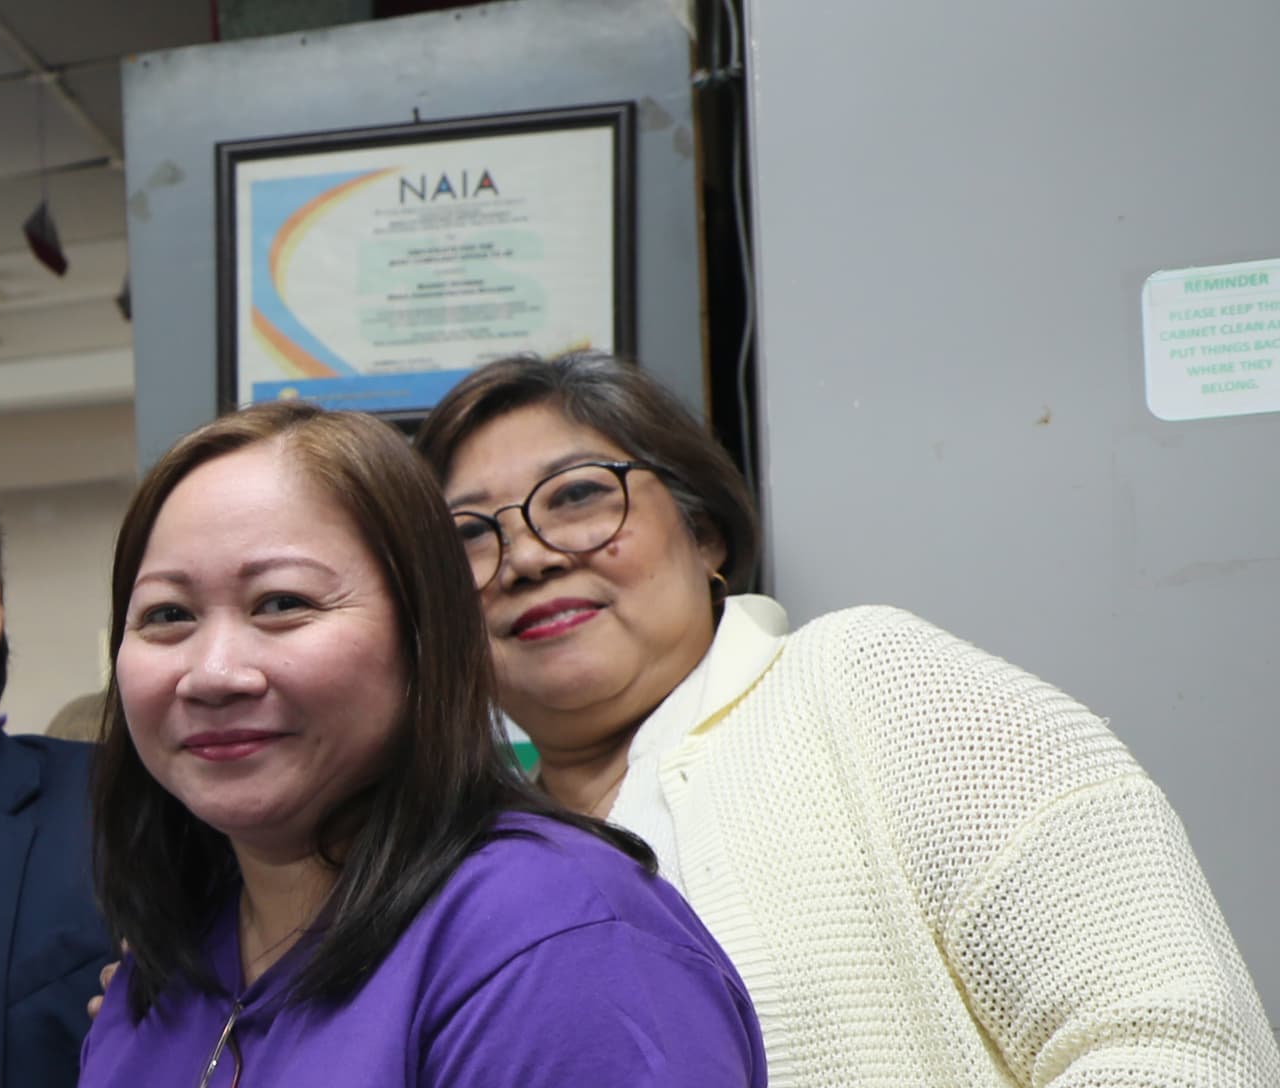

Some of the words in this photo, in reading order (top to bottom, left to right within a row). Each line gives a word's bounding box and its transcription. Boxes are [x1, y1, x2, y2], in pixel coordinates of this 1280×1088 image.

[399, 169, 500, 204] NAIA
[1184, 273, 1270, 294] REMINDER
[1168, 307, 1217, 322] PLEASE
[1220, 303, 1254, 317] KEEP
[1257, 301, 1280, 313] THI
[1160, 325, 1217, 341] CABINET
[1220, 322, 1264, 336] CLEAN
[1170, 346, 1196, 359] PUT
[1200, 342, 1252, 355] THINGS
[1254, 338, 1280, 351] BAC
[1186, 362, 1235, 376] WHERE
[1240, 358, 1273, 371] THEY
